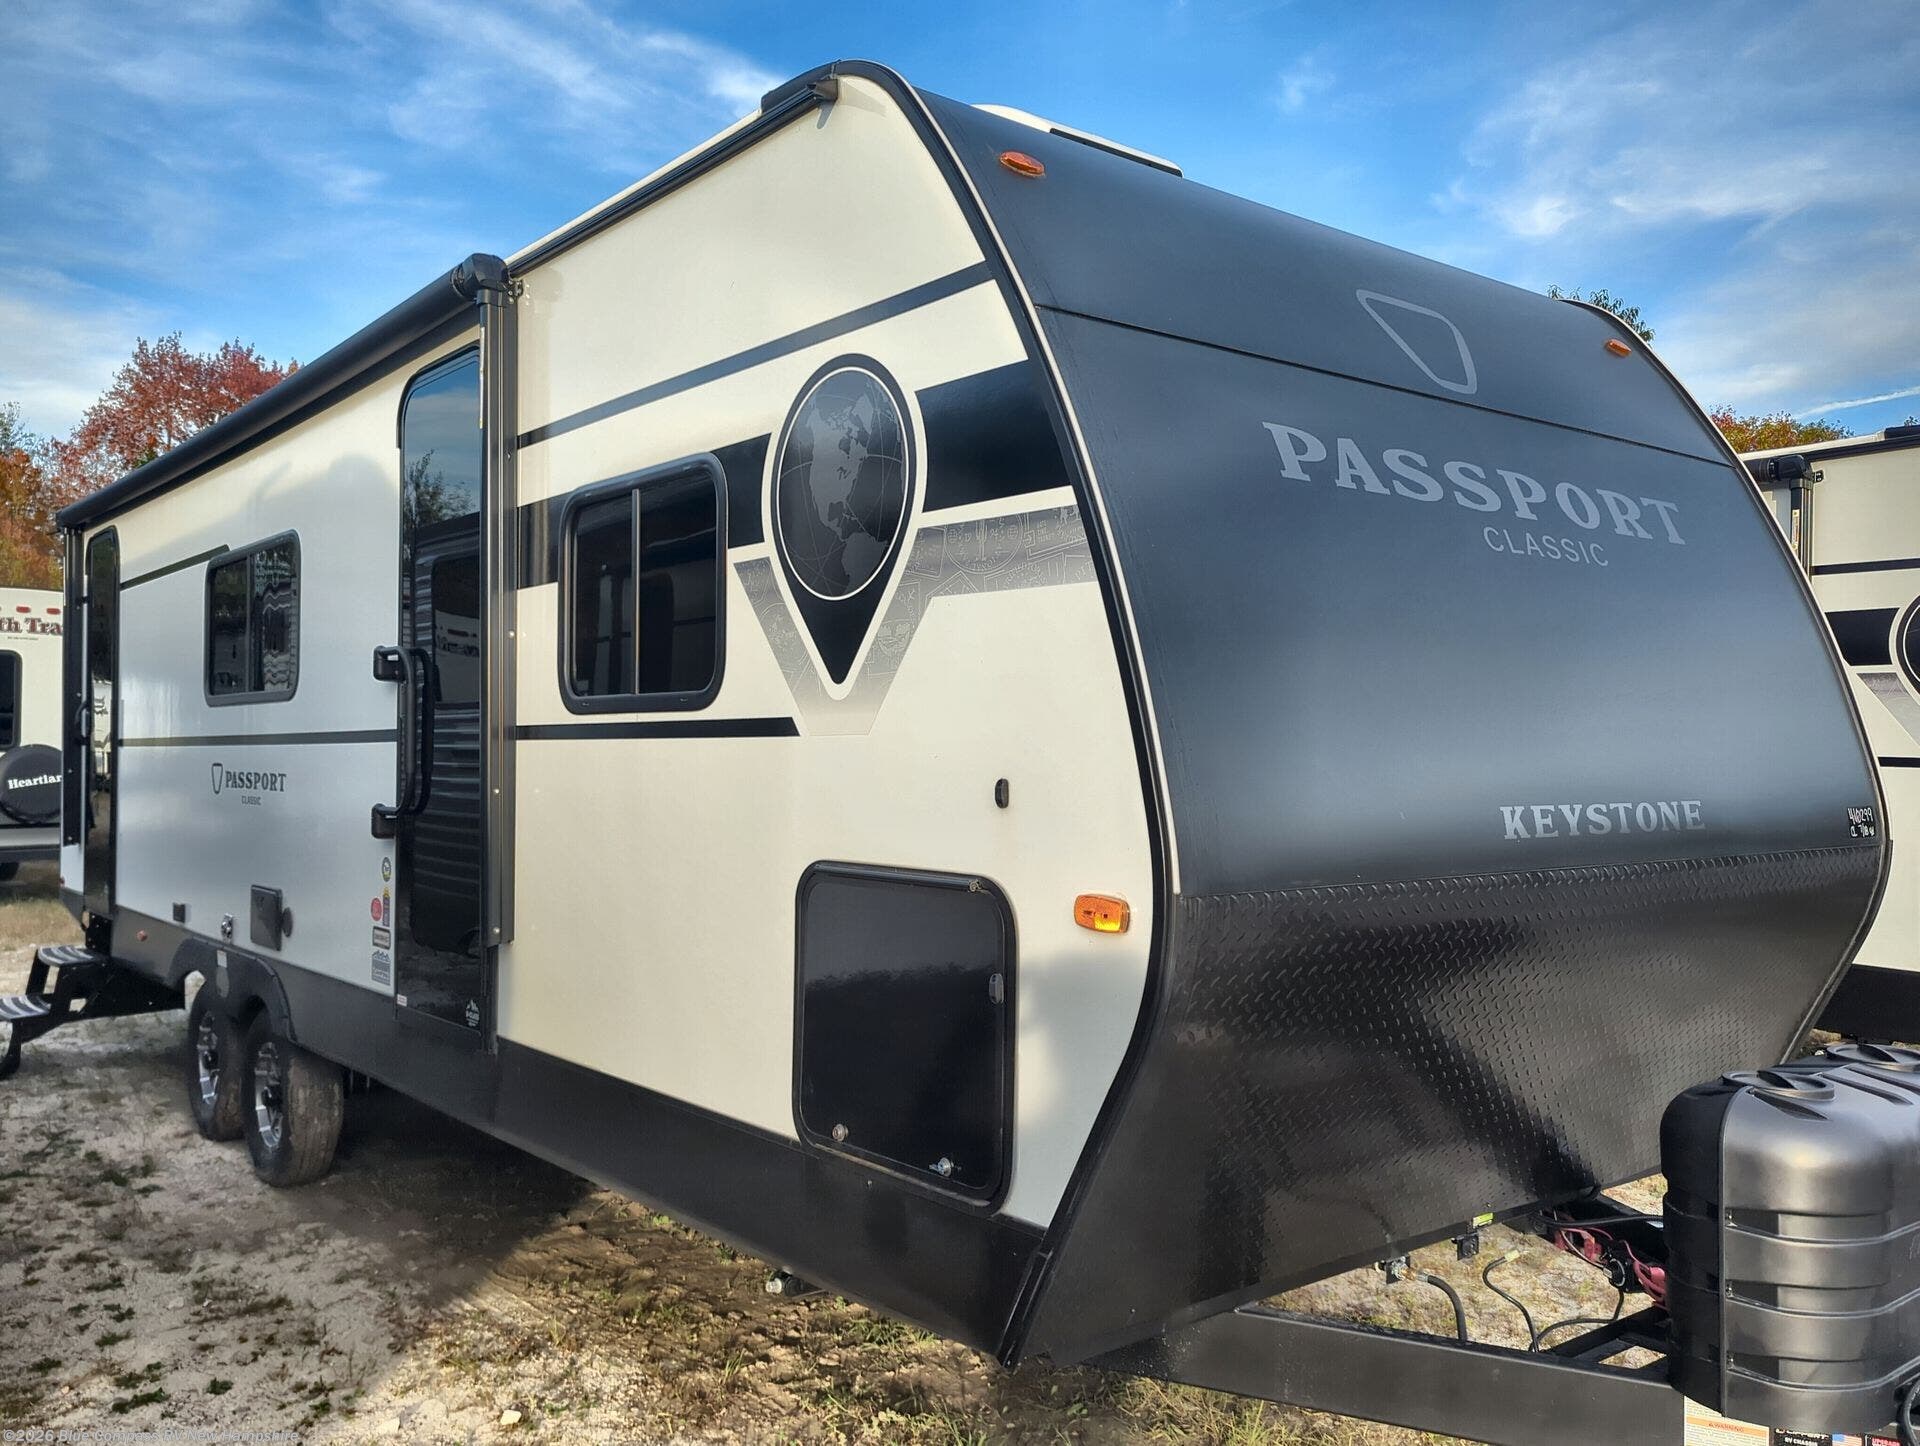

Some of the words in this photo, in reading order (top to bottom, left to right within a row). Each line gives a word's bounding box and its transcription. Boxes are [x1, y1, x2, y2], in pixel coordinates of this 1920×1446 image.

[1262, 421, 1686, 545] PASSPORT
[1483, 526, 1609, 567] CLASSIC
[225, 770, 287, 792] PASSPORT
[241, 795, 262, 806] CLASSIC
[1500, 800, 1706, 840] KEYSTONE
